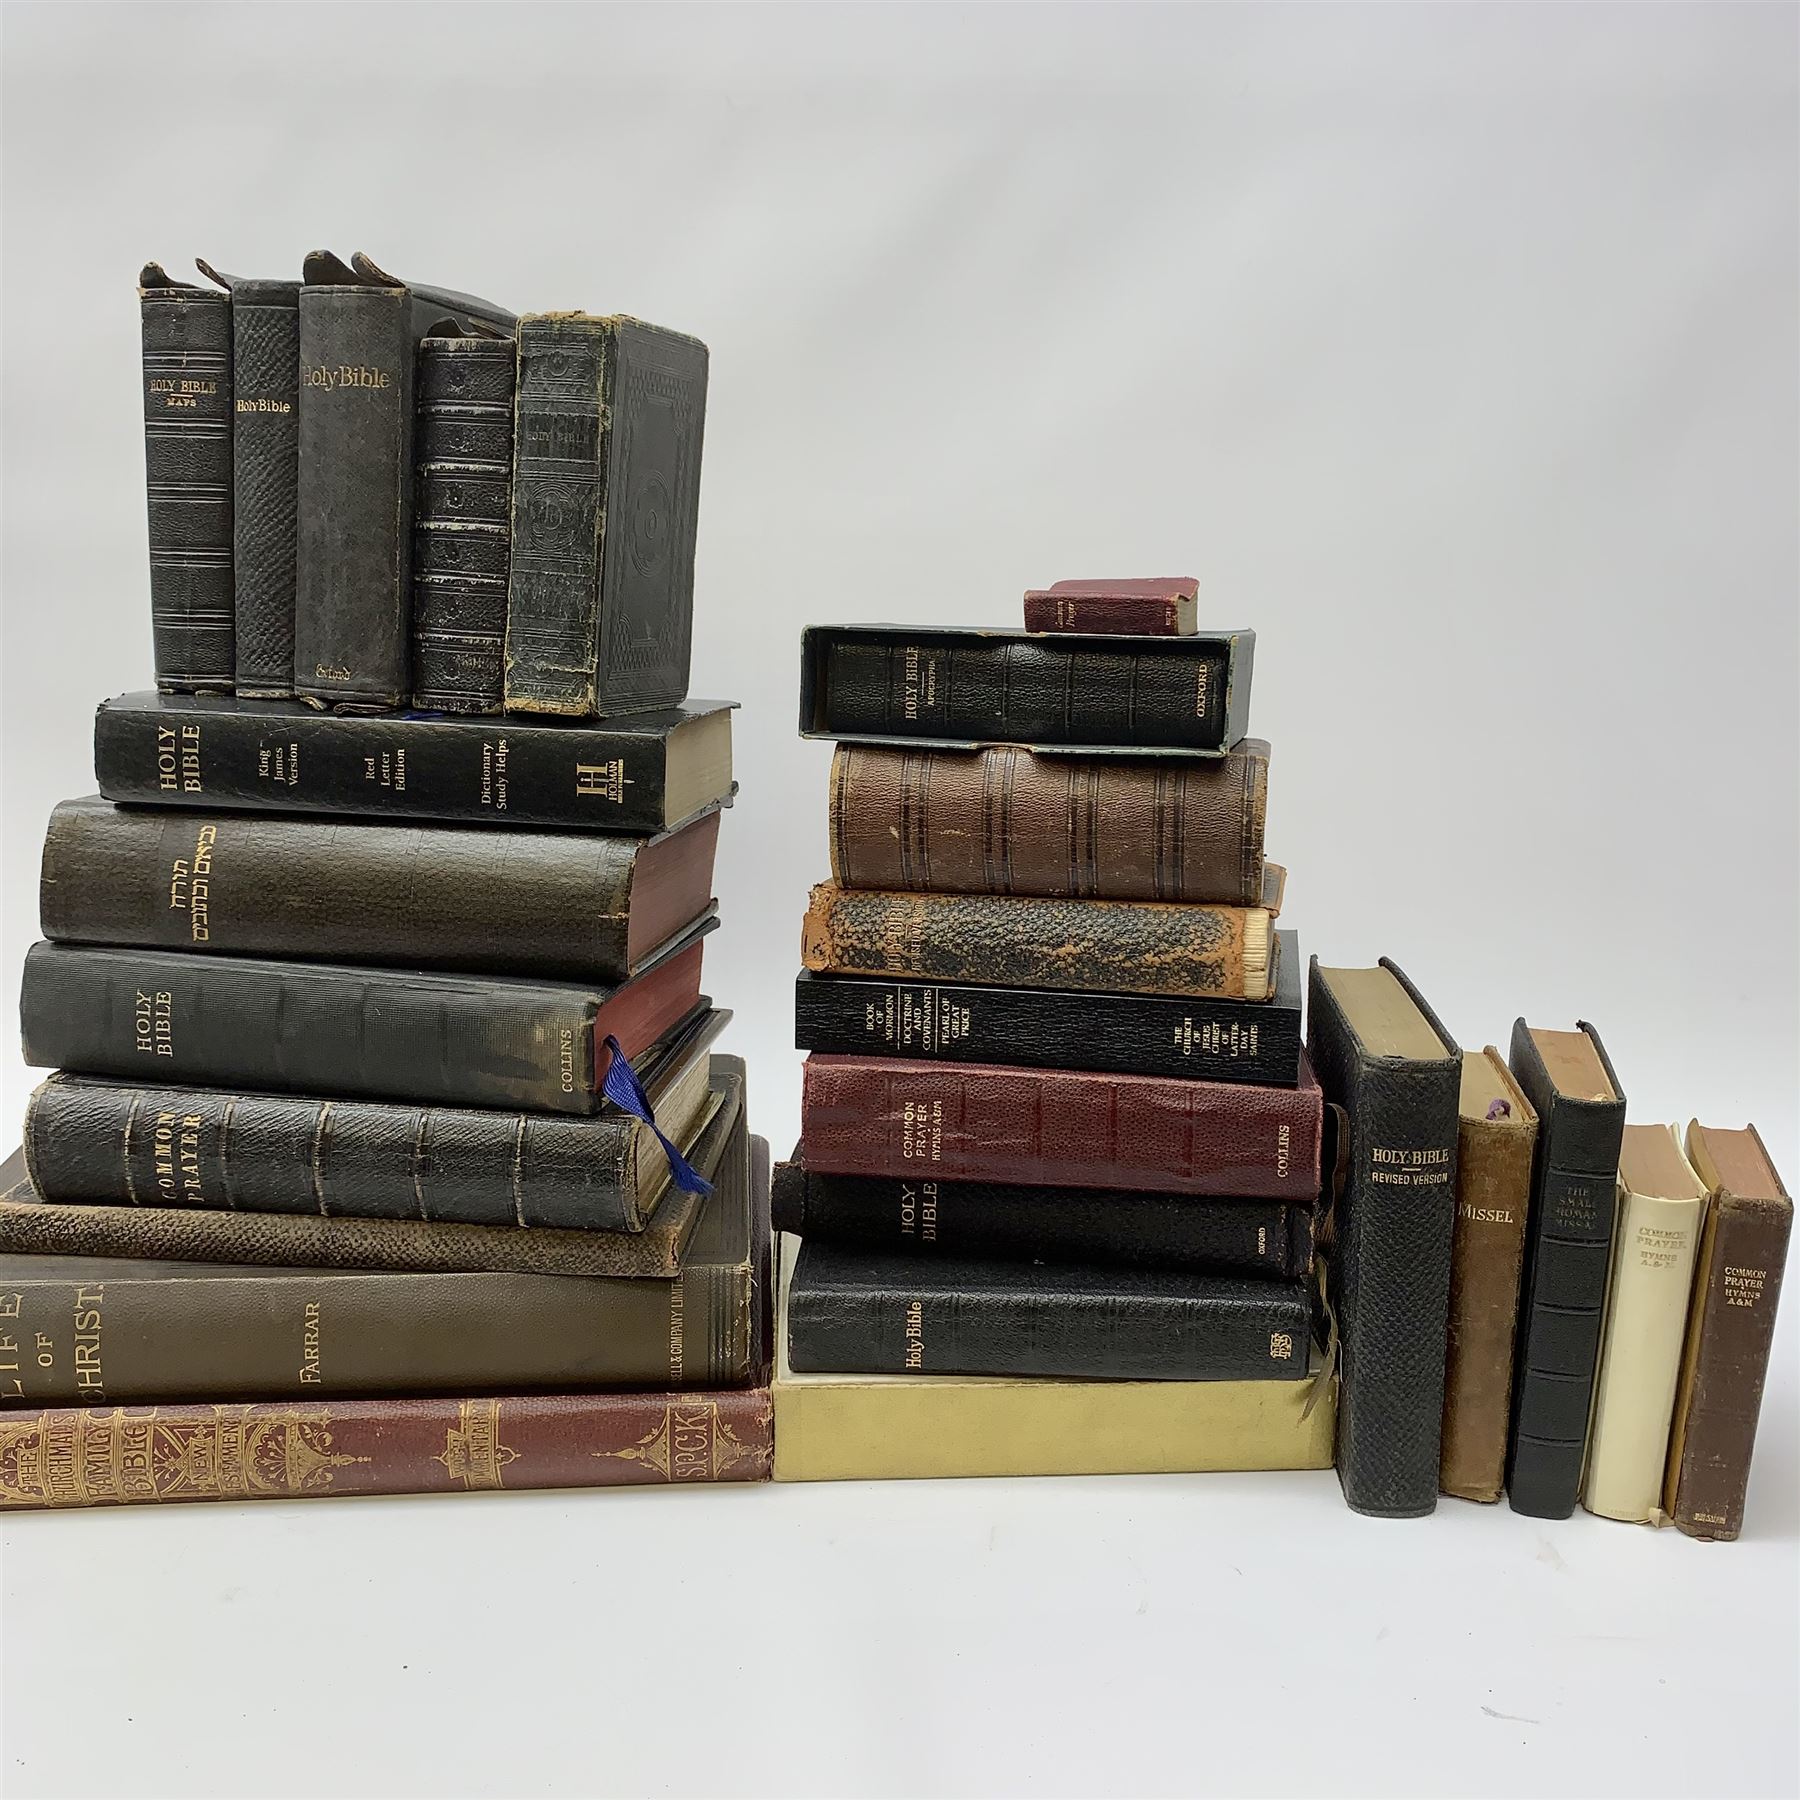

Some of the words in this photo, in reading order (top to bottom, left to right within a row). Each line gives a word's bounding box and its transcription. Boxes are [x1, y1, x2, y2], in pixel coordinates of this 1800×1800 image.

[149, 379, 176, 392] HOLY
[180, 380, 217, 393] BIBLE
[339, 367, 391, 388] Bible
[166, 398, 197, 407] MAPS
[236, 400, 259, 414] Holy
[258, 400, 291, 413] Bible
[906, 646, 919, 681] BIBLE
[905, 686, 918, 720] HOLY
[1197, 664, 1207, 718] OXFORD
[158, 725, 178, 790] HOLY
[182, 725, 202, 793] BIBLE
[258, 749, 272, 777] King
[274, 747, 286, 783] James
[288, 743, 298, 787] Version
[365, 757, 376, 780] Red
[380, 752, 391, 786] Letter
[395, 749, 406, 791] Edition
[481, 742, 495, 804] Dictionary
[496, 739, 510, 773] Helps
[496, 775, 510, 810] Study
[608, 760, 618, 801] HOLMAN
[169, 859, 189, 909] תורה
[136, 988, 152, 1052] HOLY
[865, 1003, 874, 1030] BOOK
[876, 1010, 884, 1024] OF
[885, 994, 894, 1040] MORMON
[903, 993, 912, 1044] DOCTRINE
[922, 989, 931, 1051] COVENANTS
[942, 997, 950, 1012] OF
[951, 1004, 960, 1038] GREAT
[961, 1007, 969, 1036] PRICE
[155, 991, 173, 1057] BIBLE
[942, 1013, 950, 1044] PEARL
[1174, 1026, 1183, 1044] THE
[1183, 1017, 1192, 1055] CHURCH
[1193, 1030, 1201, 1043] OF
[1202, 1025, 1211, 1049] JESUS
[1211, 1021, 1220, 1054] CHRIST
[1221, 1031, 1229, 1045] OF
[1240, 1029, 1249, 1049] DAY
[1249, 1024, 1258, 1056] SAINTS
[560, 1029, 573, 1093] COLLINS
[903, 1101, 915, 1159] COMMON
[916, 1103, 928, 1157] PRAYER
[931, 1127, 941, 1161] HYMNS
[155, 1111, 177, 1200] COMMON
[181, 1113, 205, 1202] PRAYER
[1277, 1124, 1290, 1178] COLLINS
[1372, 1147, 1406, 1164] HOLY
[1413, 1148, 1449, 1165] BIBLE
[1372, 1171, 1410, 1185] REVISED
[1413, 1172, 1448, 1186] VERSION
[901, 1183, 916, 1234] HOLY
[922, 1182, 938, 1241] BIBLE
[1458, 1200, 1514, 1224] MISSEL
[1258, 1227, 1266, 1255] OXFORD
[1724, 1266, 1767, 1279] COMMON
[1724, 1275, 1764, 1289] PRAYER
[1725, 1288, 1761, 1299] HYMNS
[670, 1310, 683, 1355] COMPANY
[906, 1301, 922, 1338] Bible
[0, 1292, 25, 1398] LIFE
[34, 1331, 53, 1367] OF
[73, 1284, 106, 1404] CHRIST.
[299, 1302, 321, 1383] FARRAR
[906, 1338, 925, 1369] Holy
[20, 1451, 38, 1485] THE
[86, 1421, 120, 1498] FAMILY
[122, 1423, 154, 1496] BIBLE
